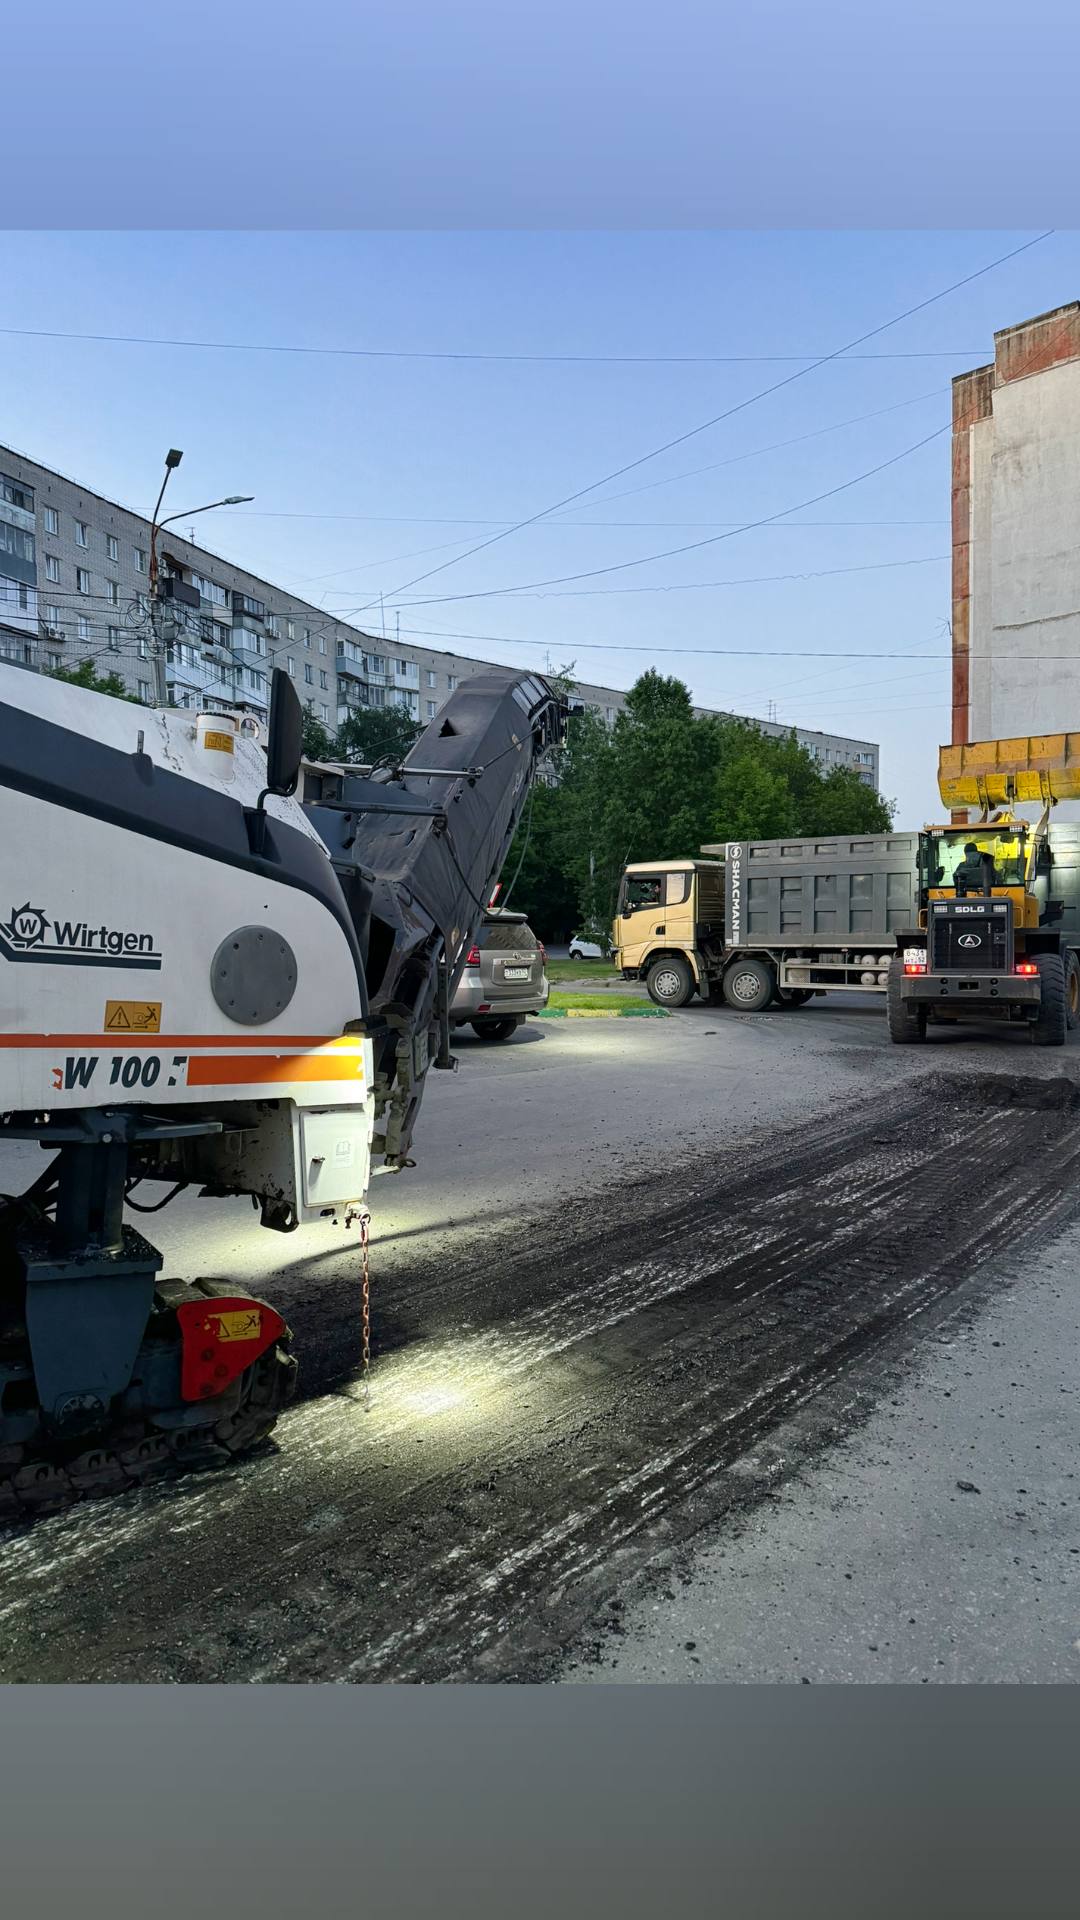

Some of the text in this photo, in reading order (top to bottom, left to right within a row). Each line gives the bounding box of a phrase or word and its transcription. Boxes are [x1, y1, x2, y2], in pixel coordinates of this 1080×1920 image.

[732, 860, 740, 930] SHACMAN
[19, 918, 37, 935] W
[53, 921, 153, 955] Wirtgen
[65, 1057, 99, 1089] W
[109, 1056, 161, 1088] 100
